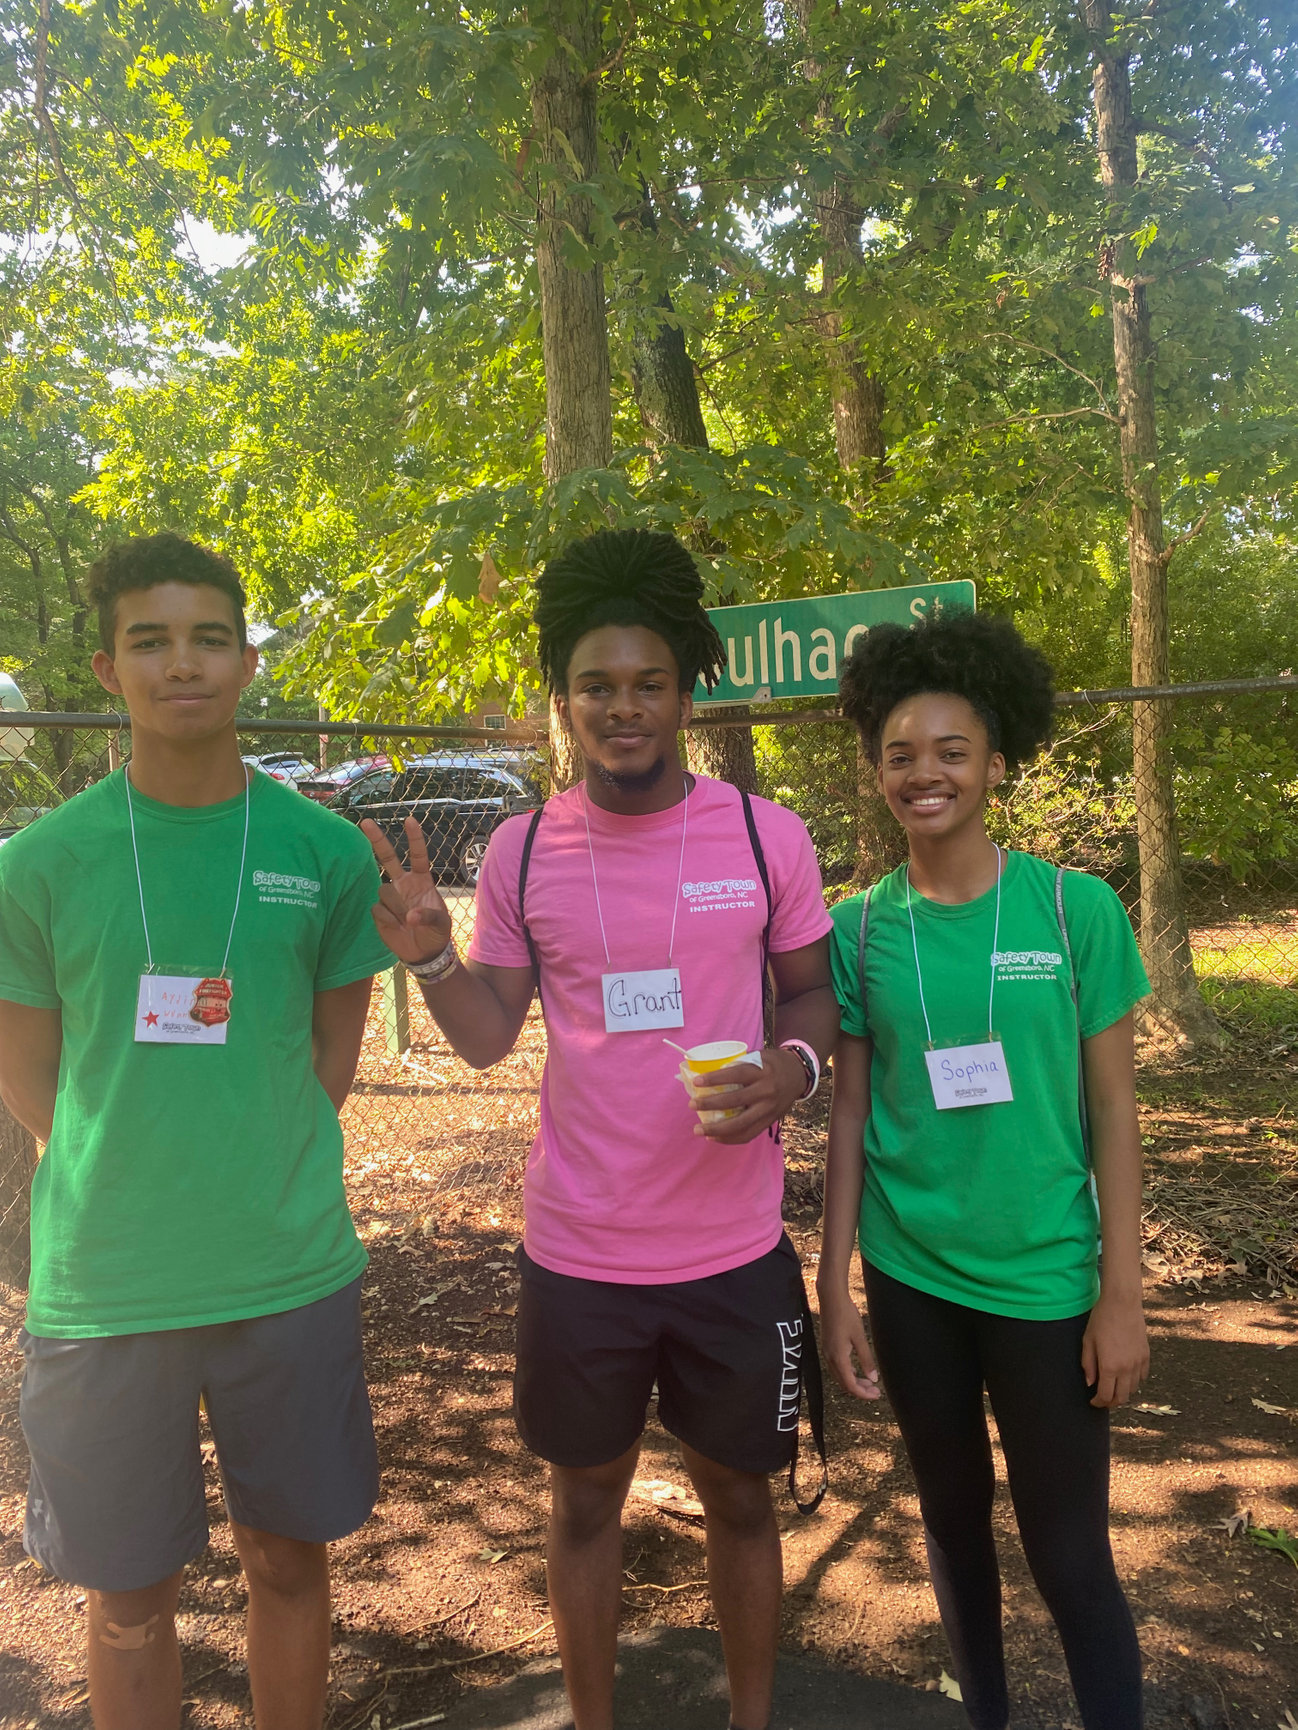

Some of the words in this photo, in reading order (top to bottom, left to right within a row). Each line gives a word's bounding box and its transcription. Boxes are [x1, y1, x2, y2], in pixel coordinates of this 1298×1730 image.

[698, 616, 870, 690] ulha
[253, 870, 293, 887] Safety
[682, 881, 723, 898] Safety
[722, 879, 757, 892] Town
[259, 896, 318, 908] INSTRUCTOR
[690, 901, 755, 912] INSTRUCTOR
[991, 951, 1030, 966] Safety
[1029, 951, 1062, 965] Town
[608, 977, 682, 1017] Grant
[941, 1059, 999, 1083] Sophia
